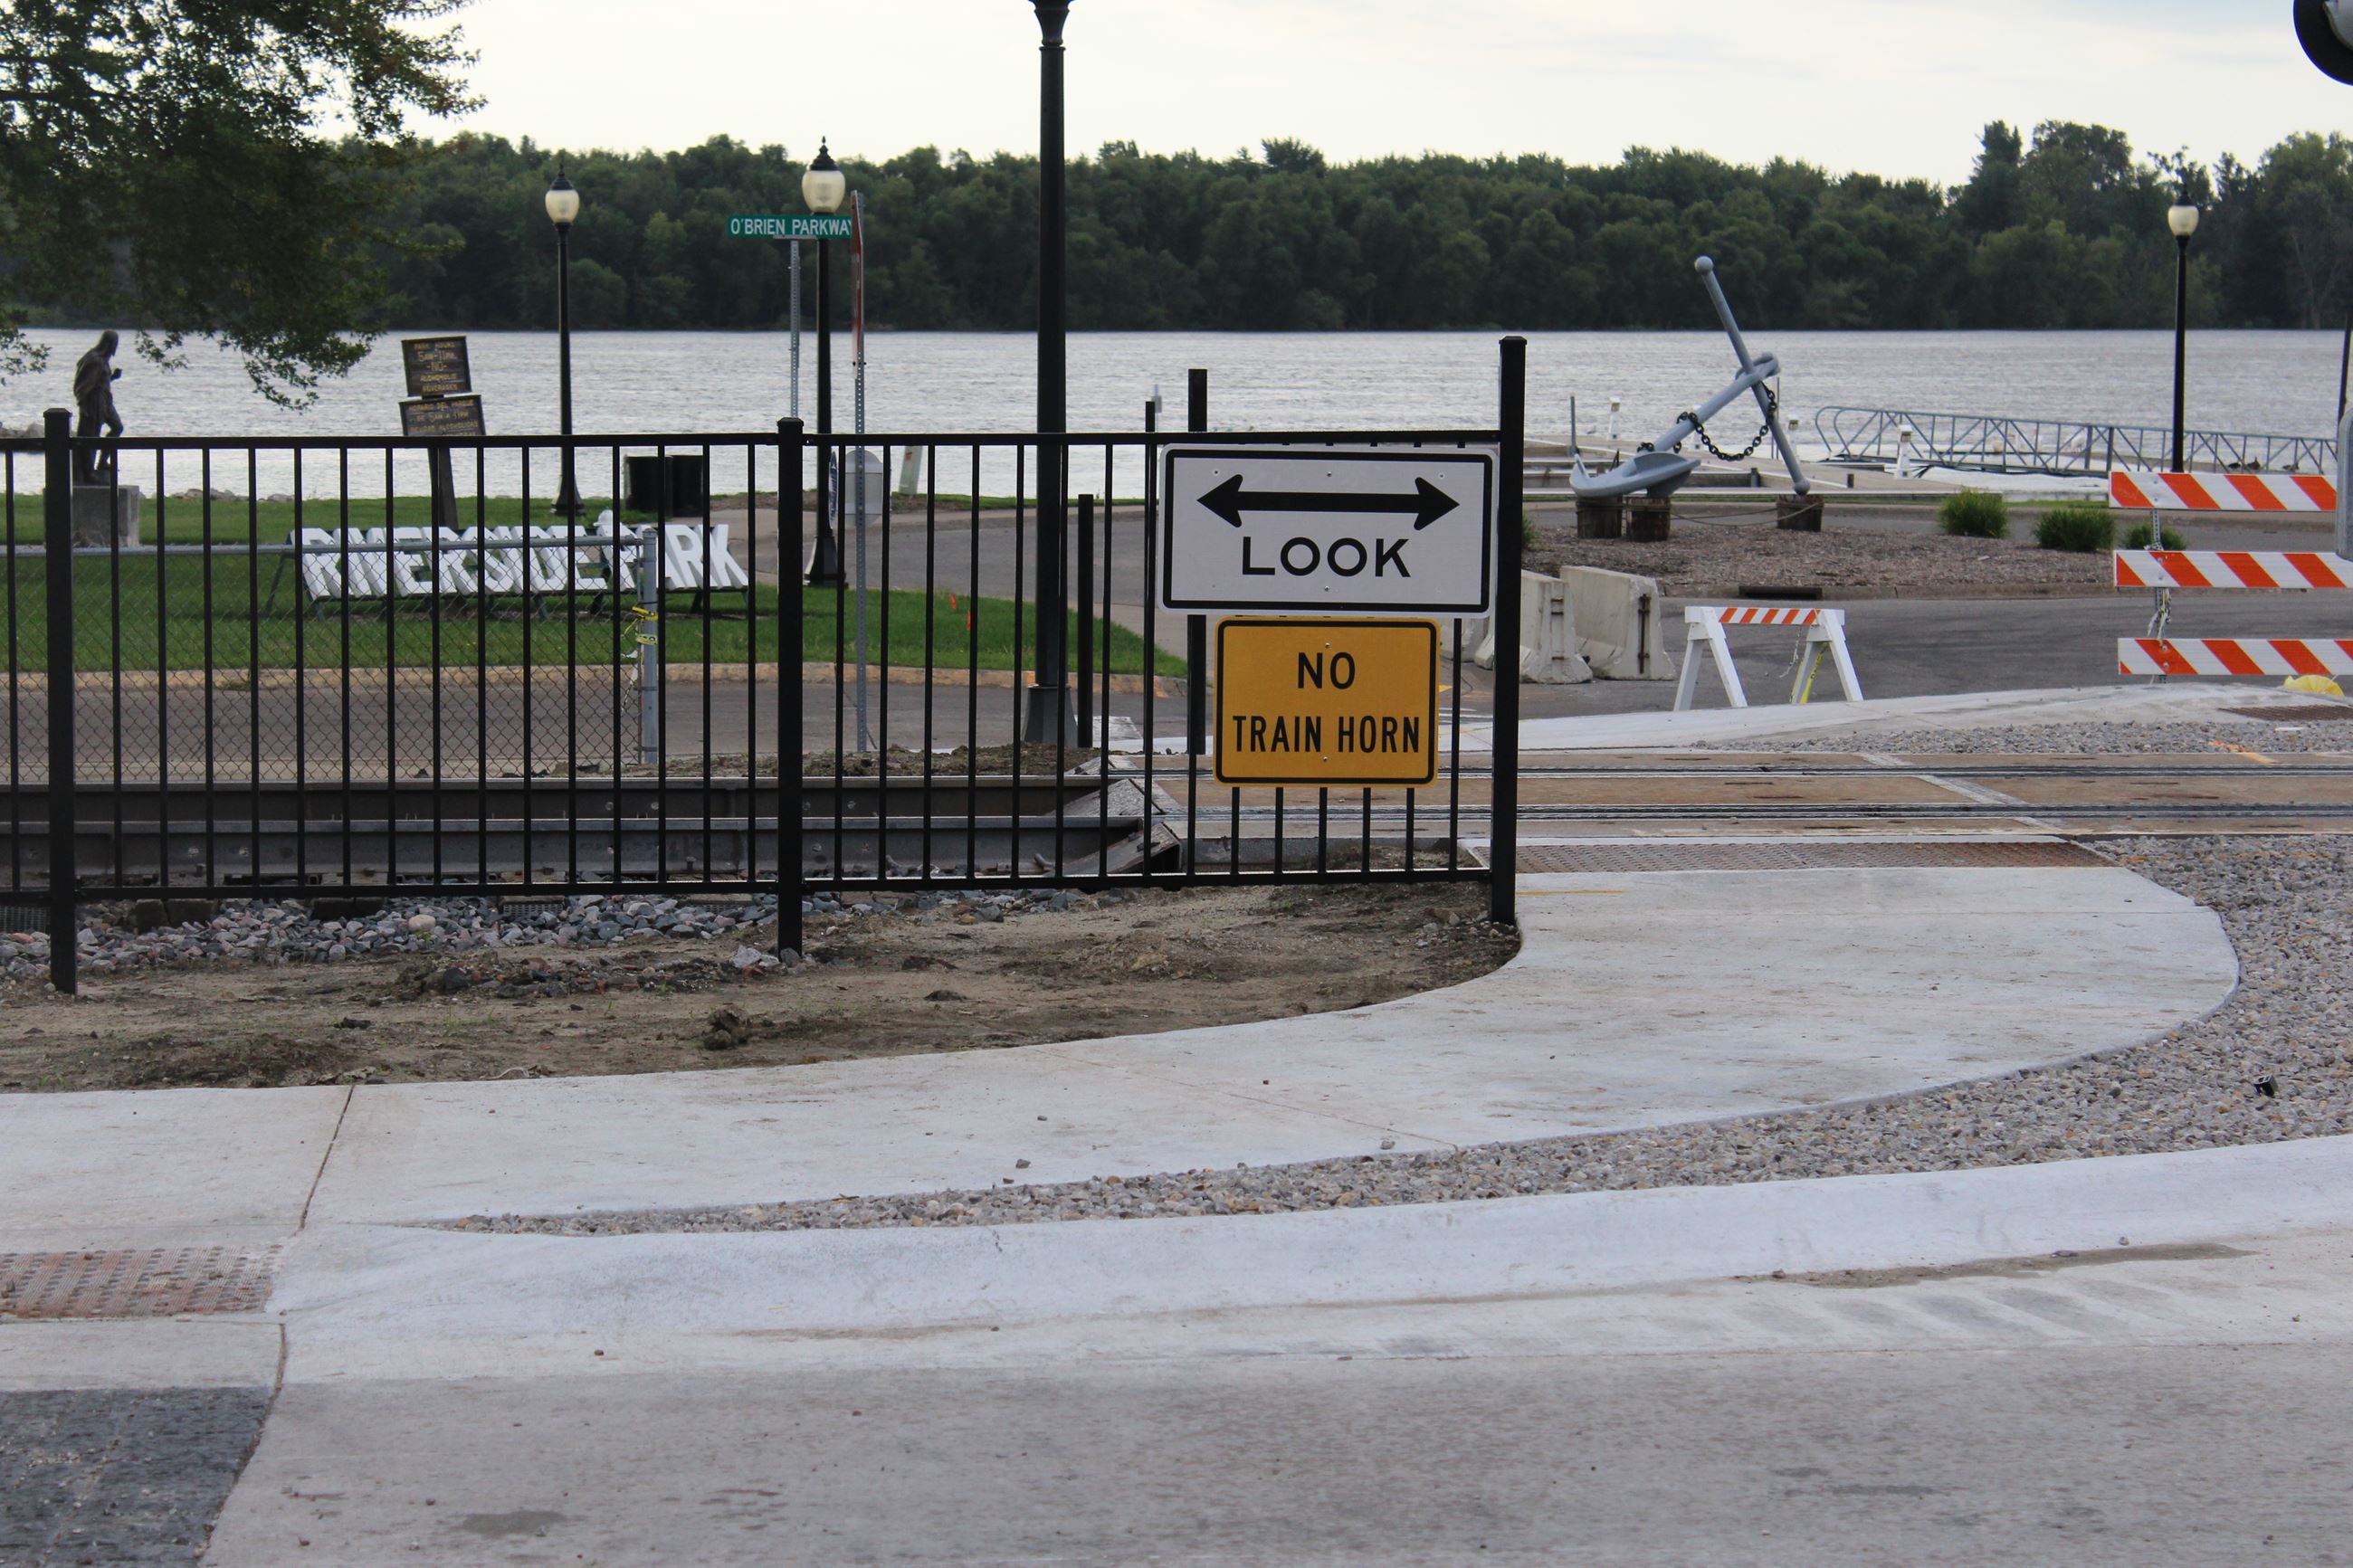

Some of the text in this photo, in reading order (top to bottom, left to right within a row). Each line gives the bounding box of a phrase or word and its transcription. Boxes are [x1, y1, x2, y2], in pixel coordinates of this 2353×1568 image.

[730, 218, 852, 235] O'BRIEN PARKWA
[290, 525, 607, 599] RIVERSIDE
[1242, 537, 1411, 577] LOOK
[1298, 652, 1356, 689] NO
[1233, 716, 1419, 754] TRAIN HORN
